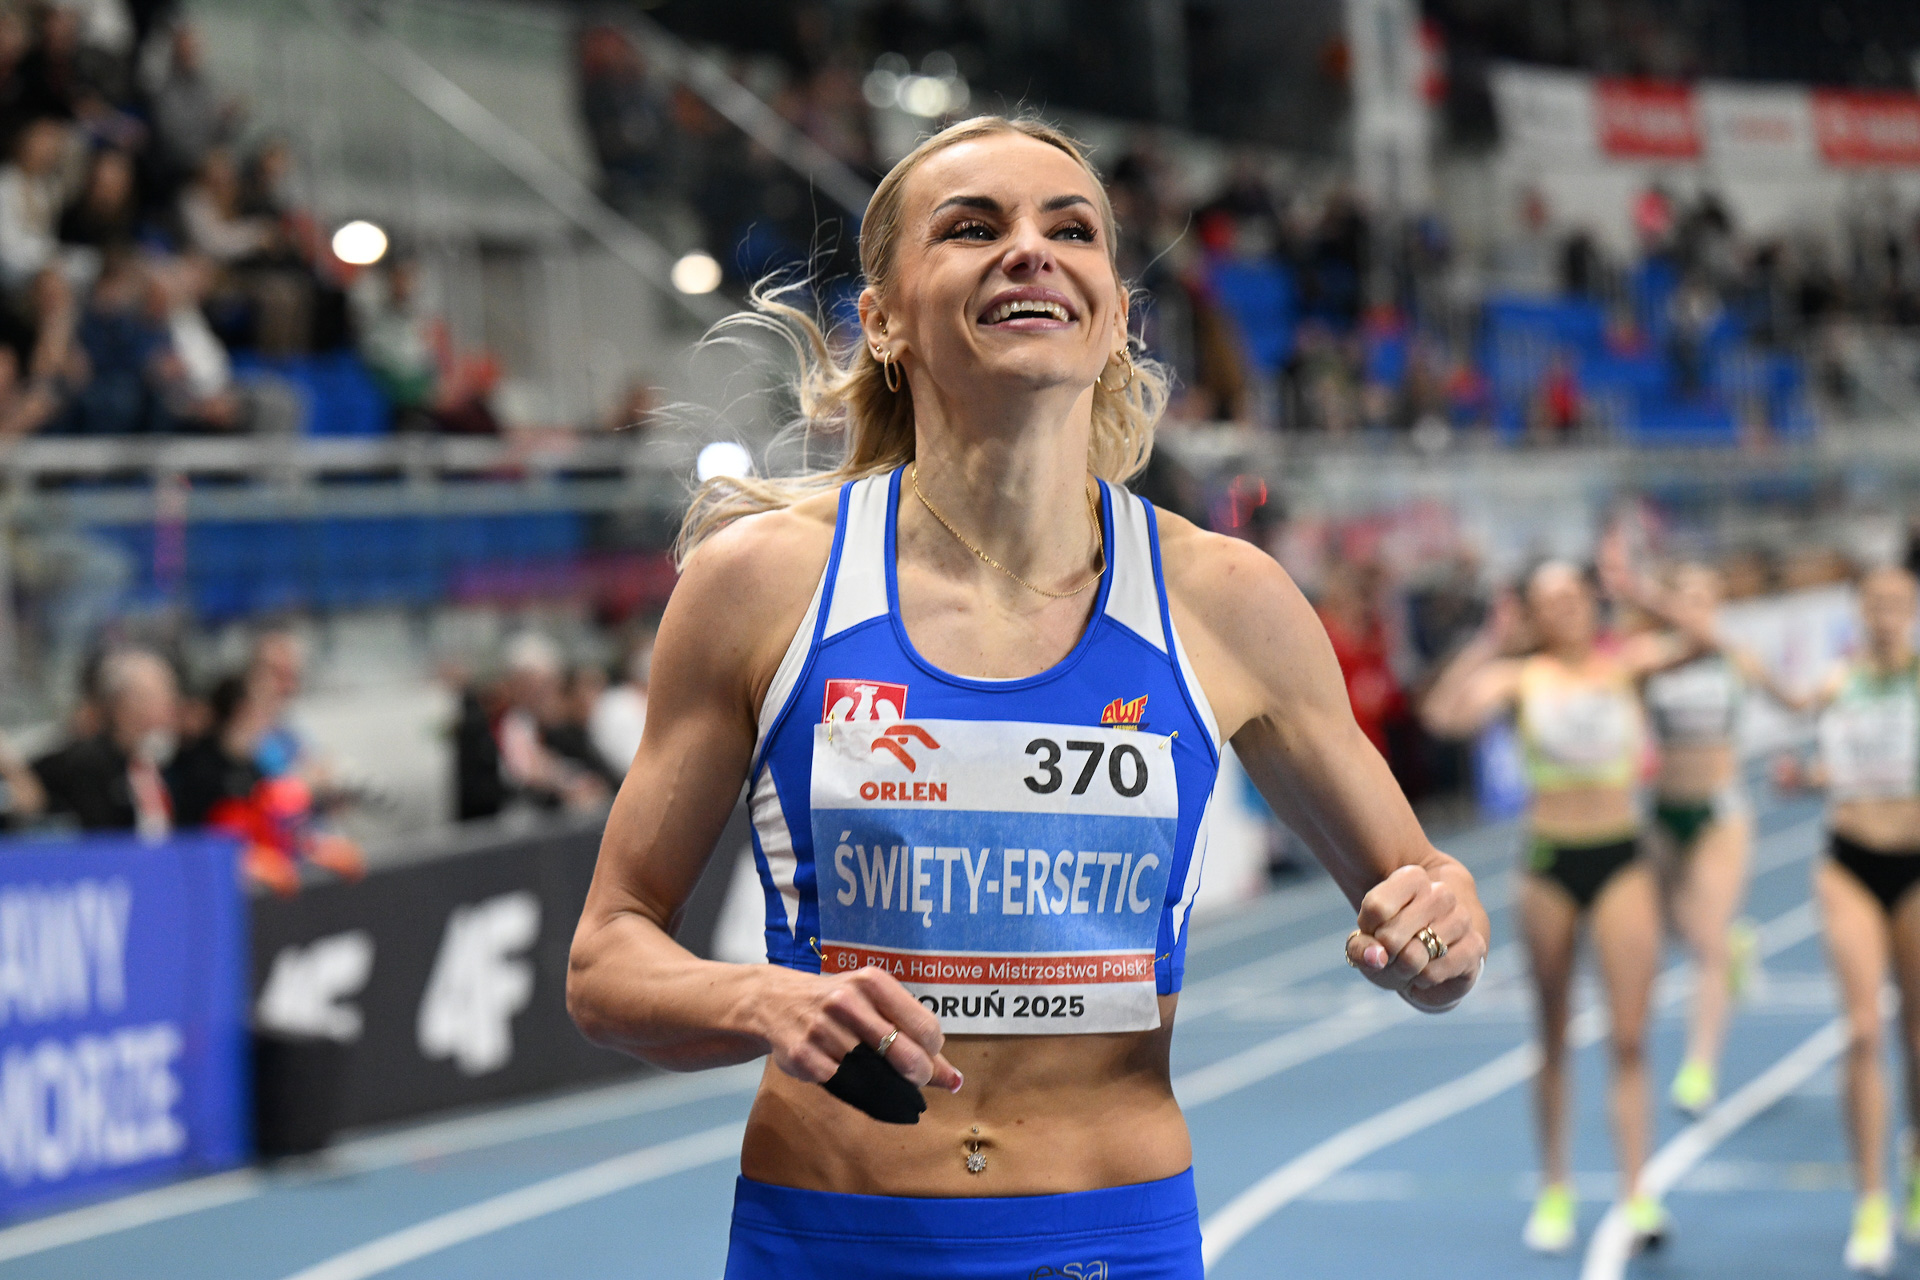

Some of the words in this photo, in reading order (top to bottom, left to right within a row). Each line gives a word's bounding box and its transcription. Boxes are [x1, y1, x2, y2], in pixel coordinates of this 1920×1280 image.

[1101, 694, 1149, 723] AWF
[1024, 738, 1149, 798] 370
[859, 781, 948, 802] ORLEN
[834, 830, 1160, 928] ŚWIĘTY-ERSETIC
[837, 952, 862, 970] 69.
[910, 961, 983, 979] Halowe
[989, 961, 1098, 979] Mistrzostwa
[1102, 958, 1147, 977] Polski
[912, 989, 1005, 1018] ORUŃ
[1013, 995, 1085, 1018] 2025
